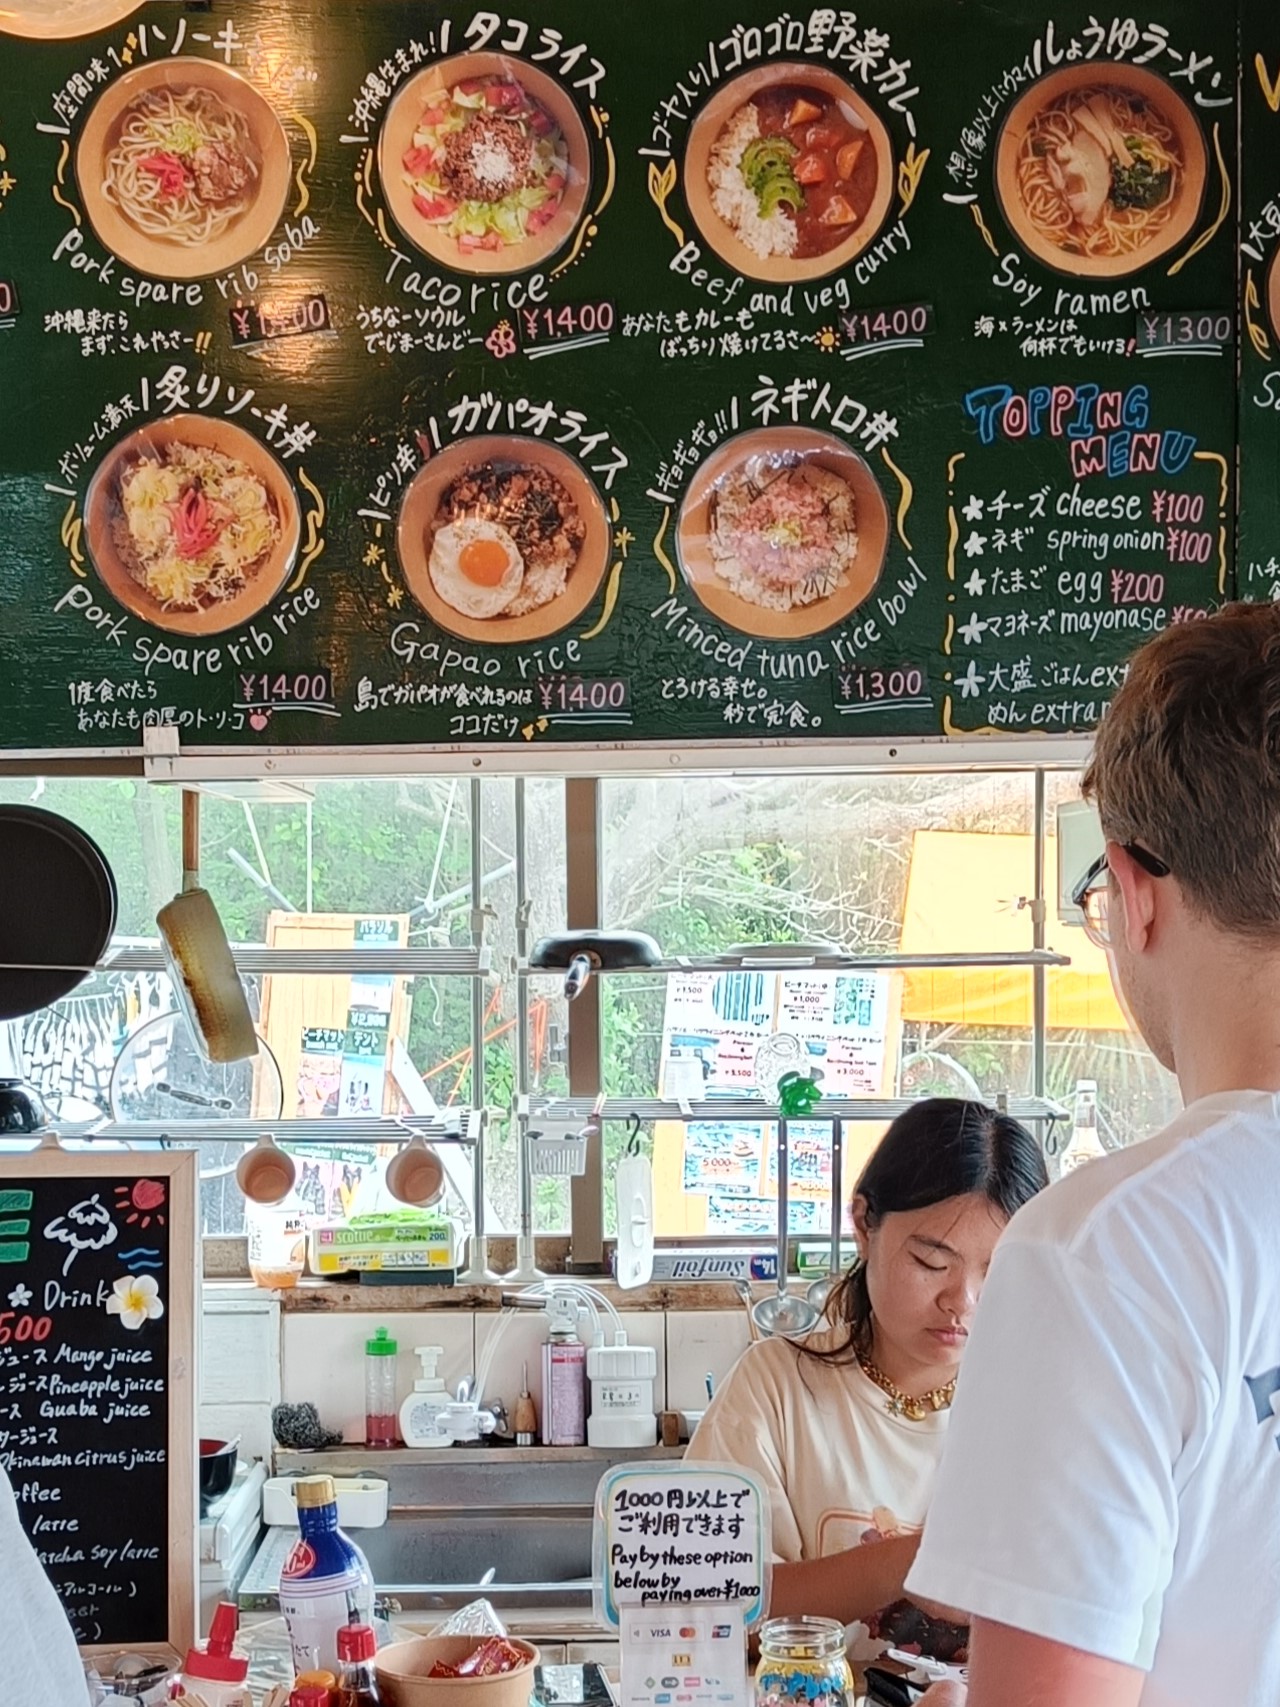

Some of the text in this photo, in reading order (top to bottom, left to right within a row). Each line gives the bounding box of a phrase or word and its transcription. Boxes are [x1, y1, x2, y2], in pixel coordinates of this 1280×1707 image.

[464, 11, 606, 99] タコライス
[1046, 15, 1233, 107] しょうゆラーメン
[719, 9, 920, 138] ゴロゴロ野菜カレー
[52, 215, 321, 306] Pork spare rib soba
[669, 220, 912, 316] Beef and veg curry
[385, 248, 549, 314] Taco rice
[992, 253, 1151, 315] Soy ramen
[44, 309, 129, 333] 沖縄来たら
[356, 305, 466, 329] うちなーソウル
[622, 308, 756, 337] あなたもカレーも
[157, 364, 318, 459] 炙りソーキ丼
[751, 374, 900, 452] ネギトロ丼
[964, 383, 1150, 444] TOPPING
[447, 391, 629, 490] ガパオライス
[1070, 430, 1197, 478] MENU
[369, 442, 418, 508] ピリ辛
[987, 483, 1205, 523] チーズ cheese ¥100
[991, 526, 1213, 563] ネギ spring onion ¥100
[990, 565, 1165, 604] たまご egg ¥200
[54, 583, 321, 676] Pork spare rib rice
[650, 556, 928, 679] Minced tuna rice bowl
[987, 609, 1056, 638] マヨネーズ
[1060, 605, 1167, 642] mayonase
[389, 621, 582, 680] Gapao rice
[661, 676, 768, 701] とろける幸せ。
[987, 655, 1130, 693] 大盛 ごはん ext
[449, 714, 519, 738] ココだけ
[722, 699, 823, 729] 秒で完食。
[988, 702, 1027, 725] めん
[1031, 700, 1097, 725] extra
[671, 1258, 745, 1279] Sunfoil
[44, 1279, 110, 1312] Drink
[53, 1343, 103, 1371] Mango
[103, 1348, 153, 1371] juice
[49, 1375, 120, 1399] Pineapple
[120, 1377, 164, 1400] juice
[40, 1400, 98, 1418] Guaba
[102, 1402, 152, 1424] juice
[74, 1450, 127, 1467] citrus
[124, 1448, 166, 1471] juice
[13, 1481, 61, 1503] offee
[614, 1489, 750, 1512] 1000円以上で
[618, 1511, 745, 1539] ご利用できます
[35, 1546, 85, 1565] atcha
[611, 1543, 753, 1570] Pay by these option
[614, 1570, 681, 1589] below by
[641, 1588, 691, 1607] paying
[650, 1629, 671, 1638] VISA
